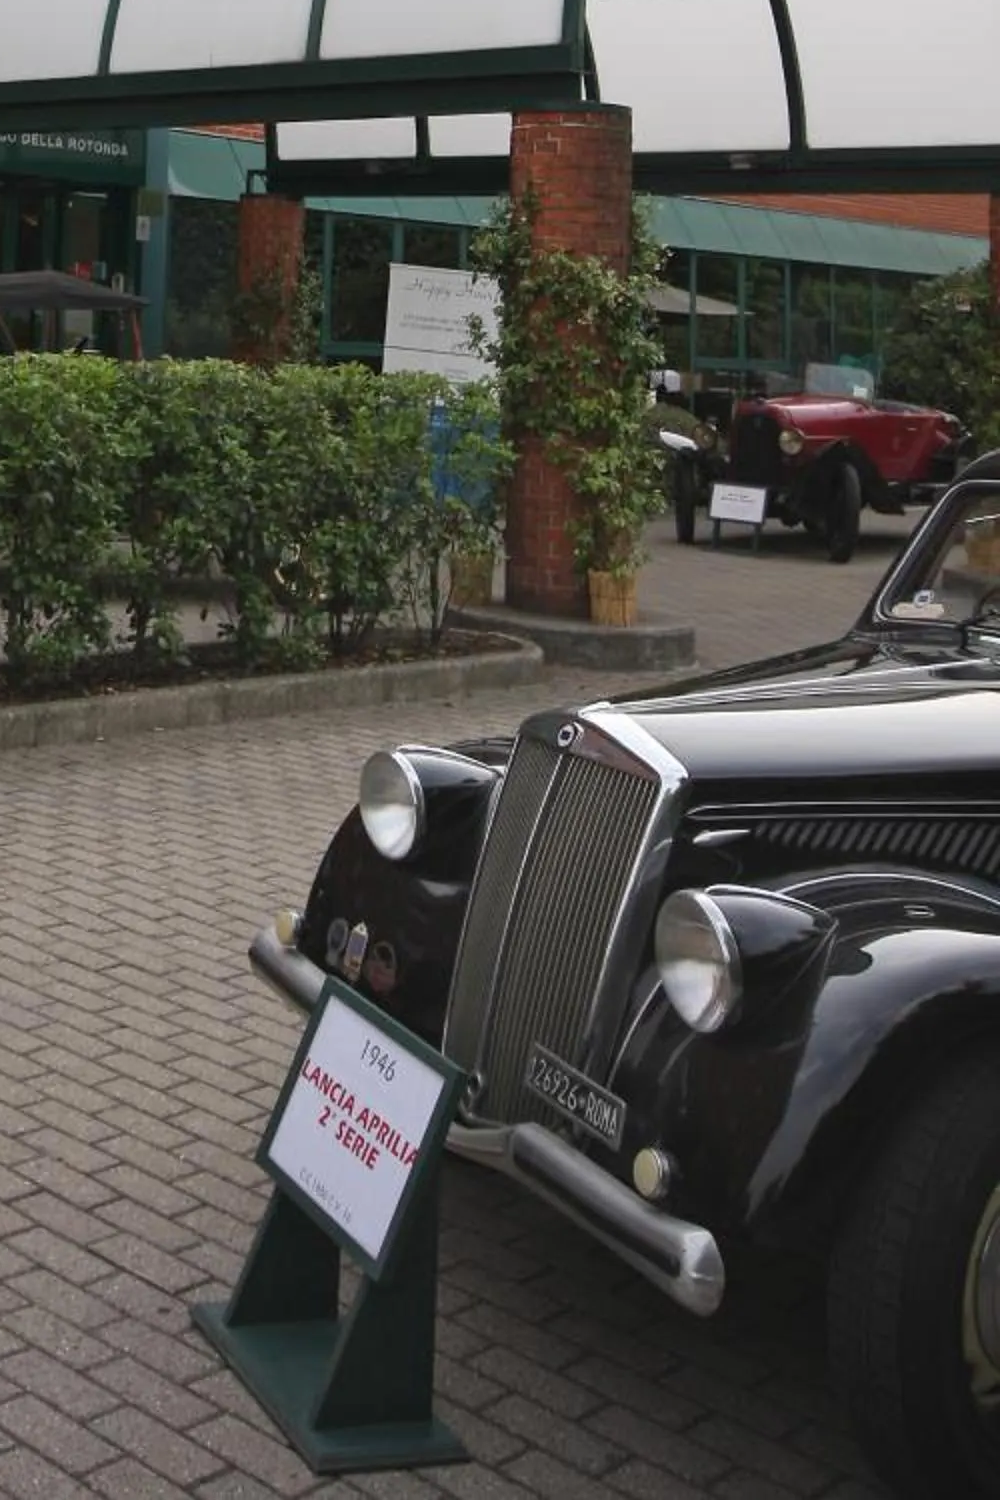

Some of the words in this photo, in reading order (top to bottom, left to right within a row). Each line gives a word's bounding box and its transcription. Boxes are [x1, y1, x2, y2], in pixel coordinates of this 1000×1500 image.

[21, 132, 63, 149] DELLA
[67, 137, 129, 157] ROTONDA
[360, 1039, 396, 1083] 1946
[301, 1058, 355, 1118] LANCIA
[356, 1108, 420, 1167] APRILIA
[335, 1121, 380, 1170] SERIE
